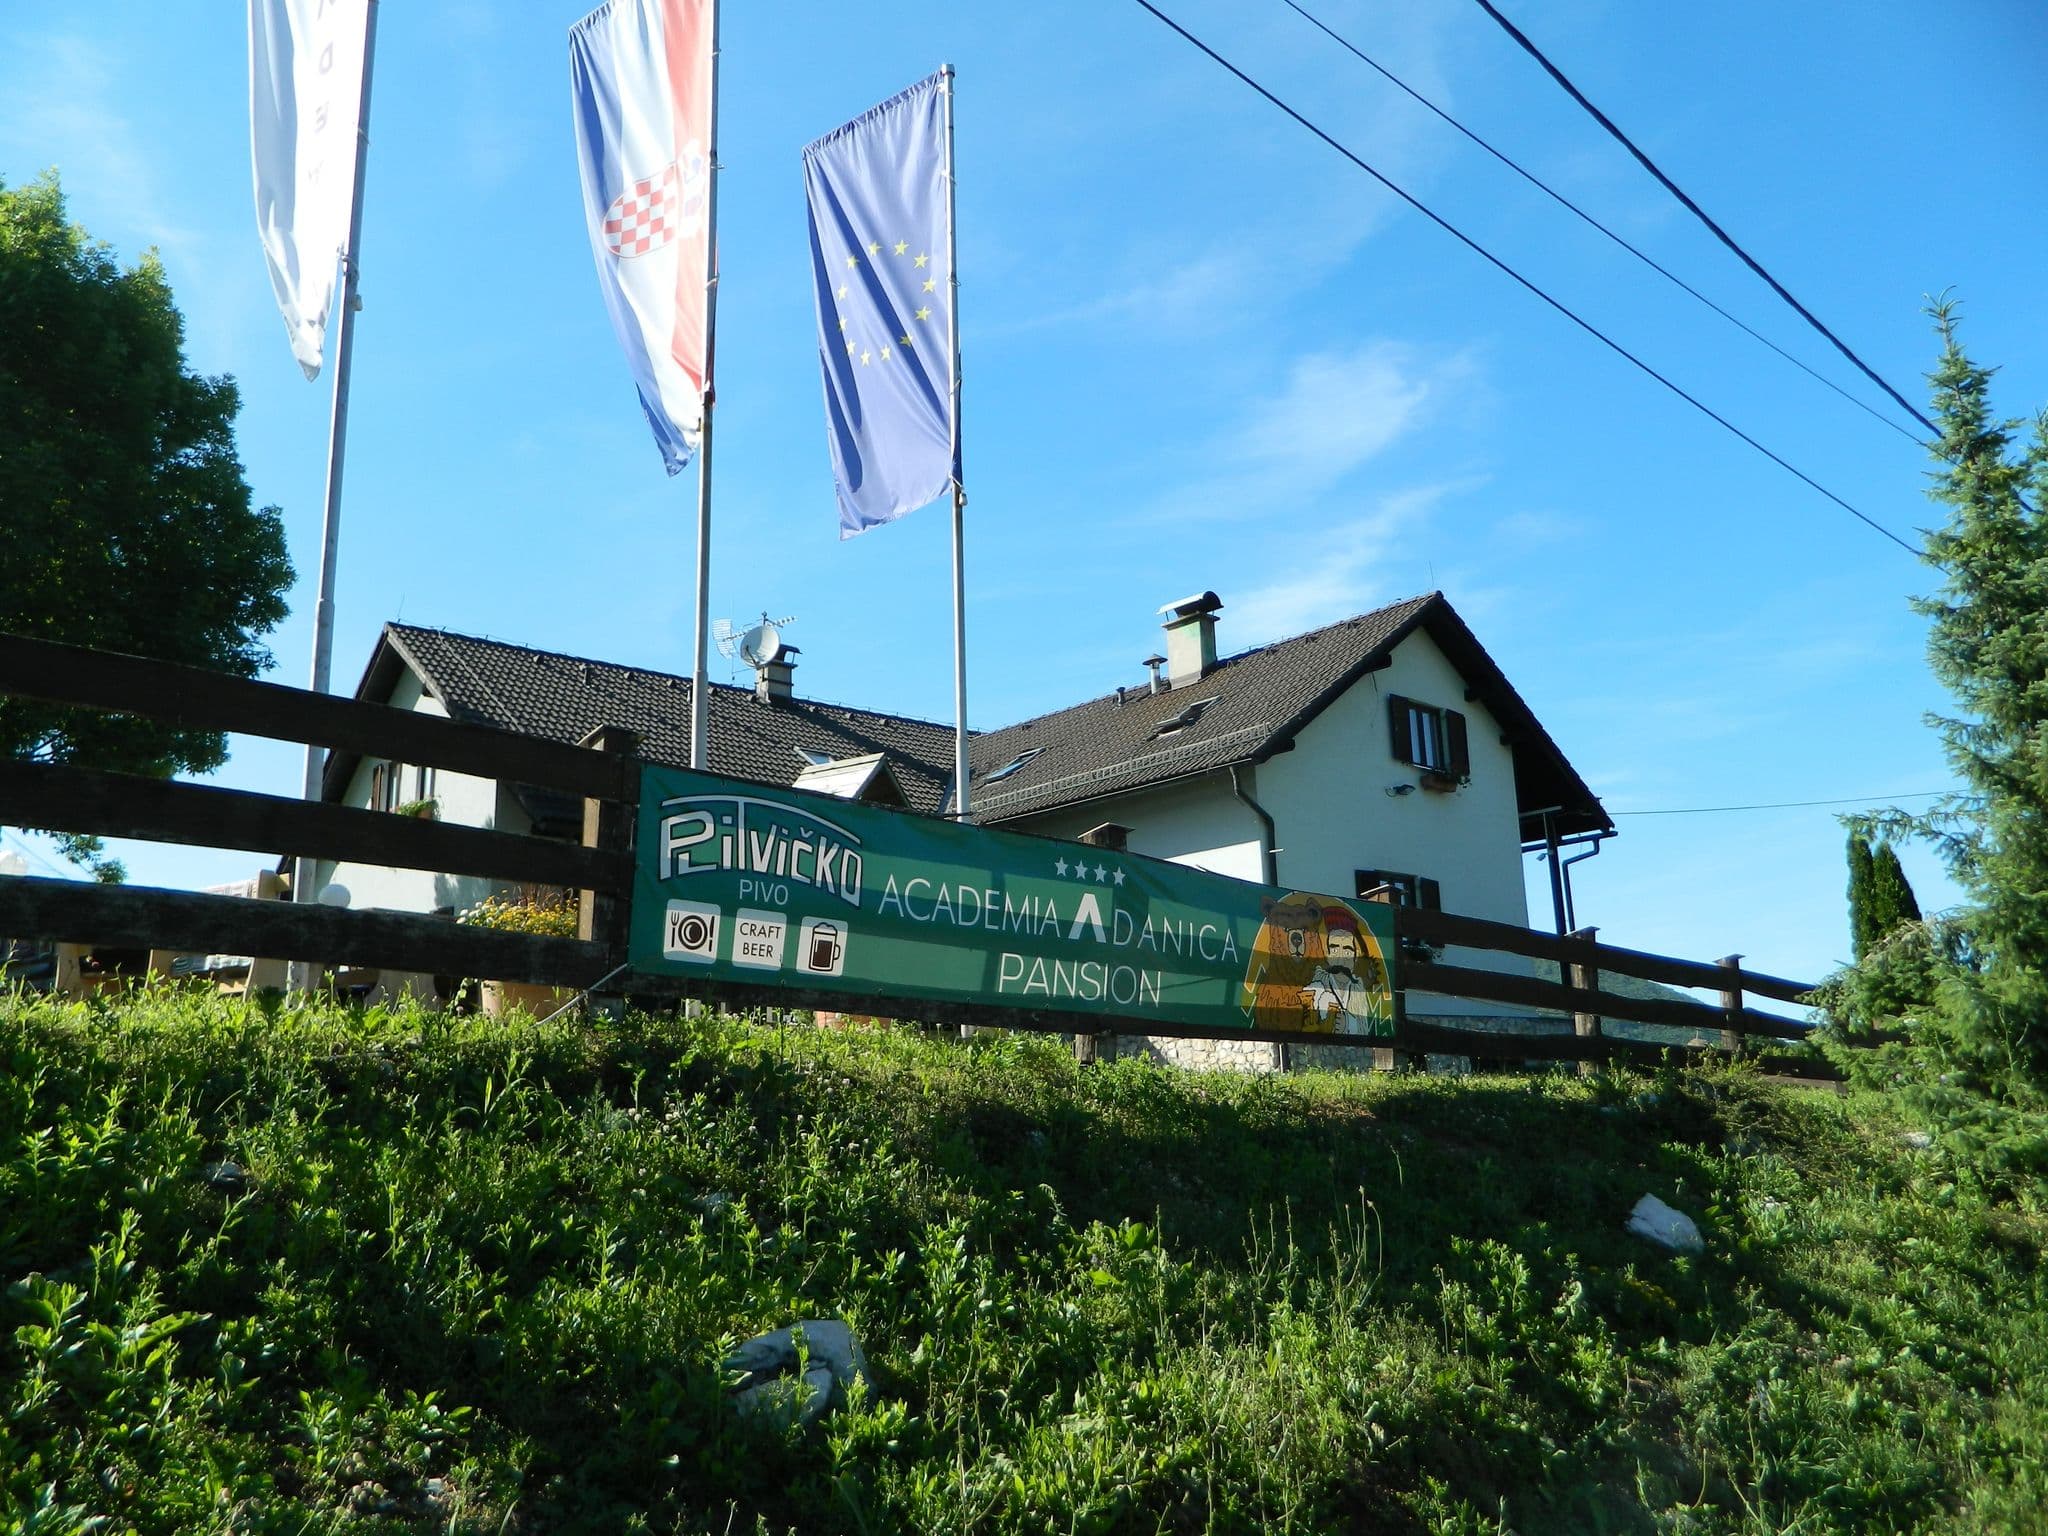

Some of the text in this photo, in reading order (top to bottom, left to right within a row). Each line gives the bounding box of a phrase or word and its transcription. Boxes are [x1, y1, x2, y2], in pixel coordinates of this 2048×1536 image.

[739, 879, 789, 905] PIVO
[740, 922, 782, 939] CRAFT
[878, 874, 1061, 938] ACADEMIA
[1113, 909, 1238, 963] DANICA
[742, 942, 774, 958] BEER
[998, 953, 1162, 1008] PANSION
